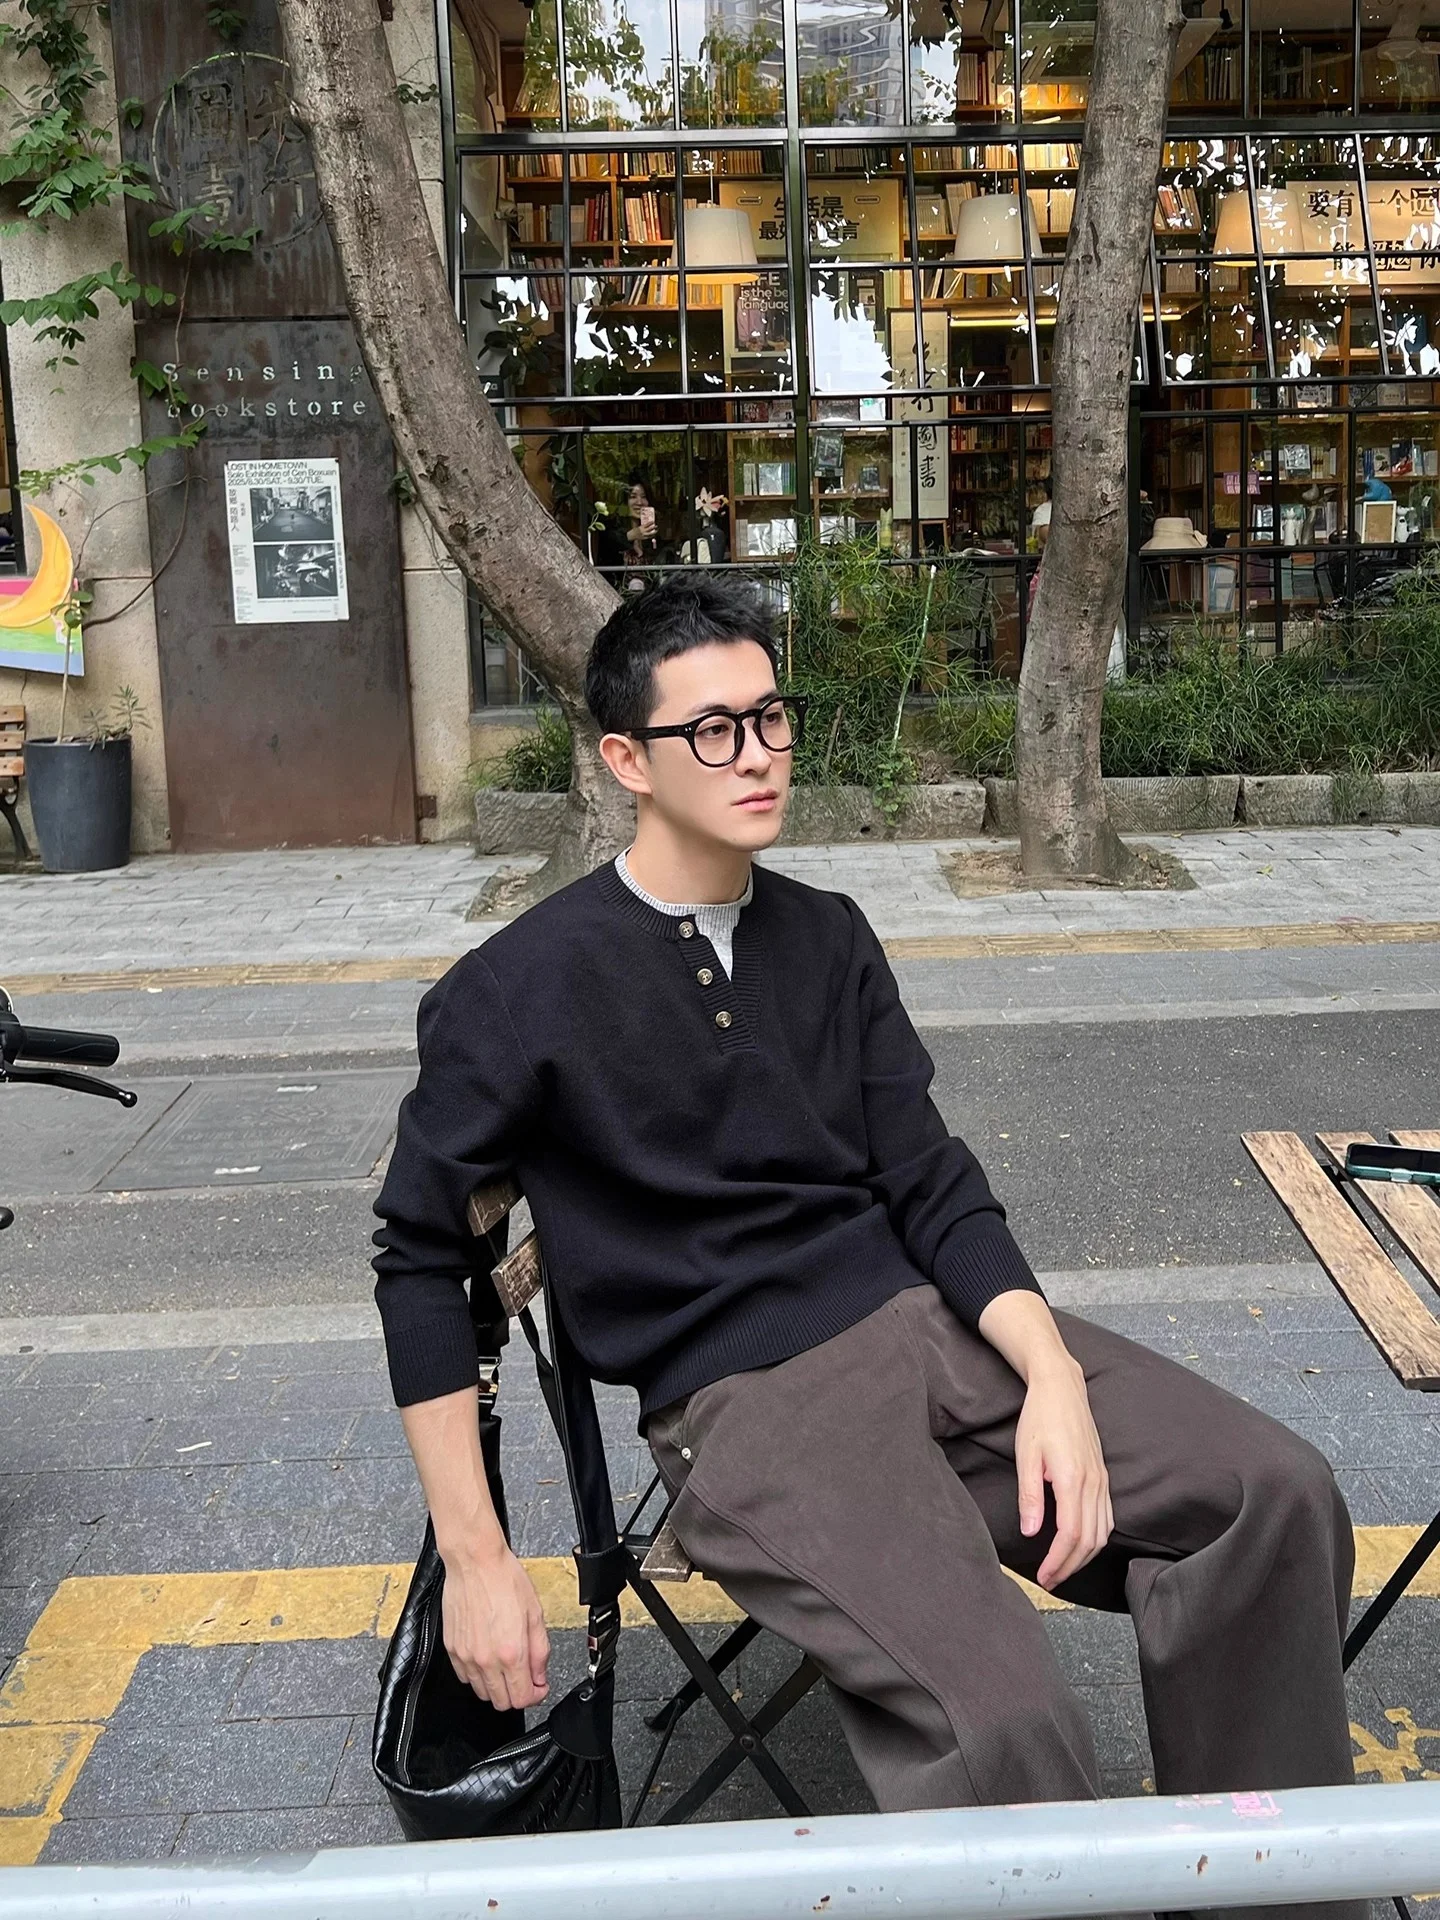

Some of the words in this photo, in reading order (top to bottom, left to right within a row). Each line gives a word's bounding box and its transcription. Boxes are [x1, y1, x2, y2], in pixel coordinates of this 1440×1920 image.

[741, 287, 750, 298] is
[751, 287, 772, 298] the
[774, 287, 788, 298] be
[741, 298, 789, 312] languag
[163, 361, 363, 385] Sensing
[165, 397, 366, 419] bookstore
[258, 462, 308, 470] HOMETOWN
